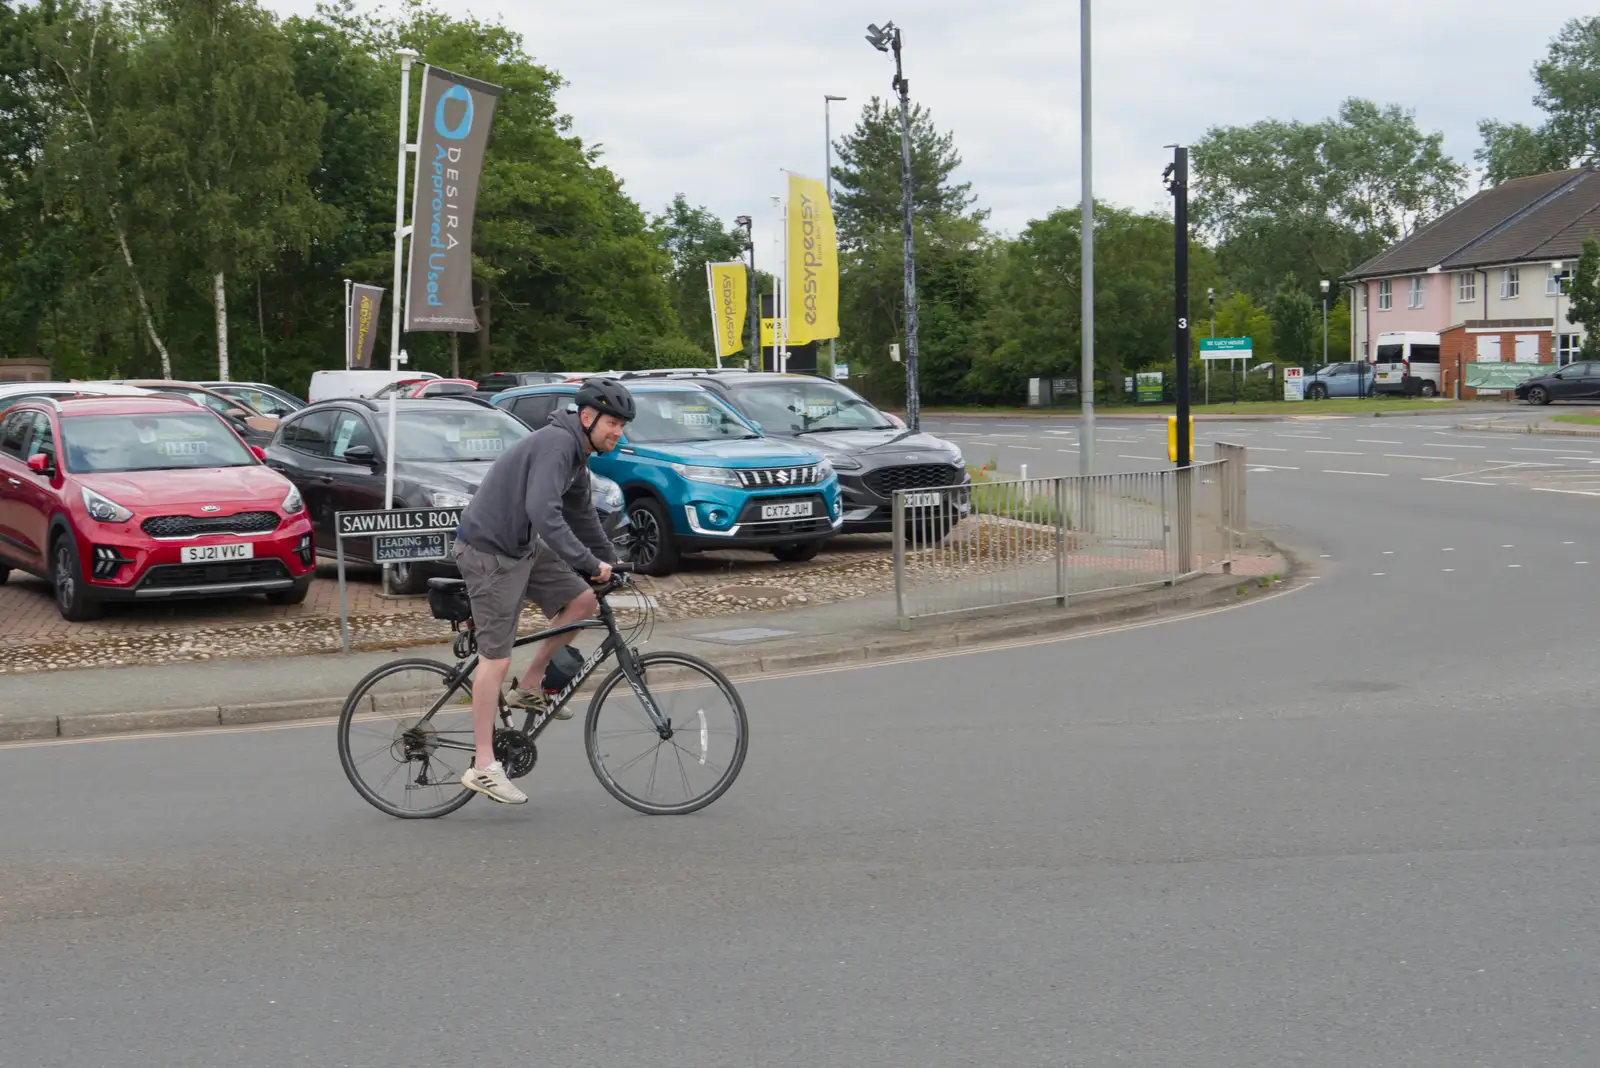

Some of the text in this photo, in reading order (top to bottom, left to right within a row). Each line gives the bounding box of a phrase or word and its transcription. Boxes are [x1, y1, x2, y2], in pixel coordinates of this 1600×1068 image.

[445, 146, 463, 251] DESIRA
[426, 143, 448, 307] Approved Used
[800, 193, 822, 326] easypeasy
[1178, 317, 1187, 329] 3
[766, 502, 809, 517] CX72 JUH
[342, 511, 461, 532] SAWMILLS ROA
[380, 535, 441, 548] LEADING TO
[190, 545, 245, 560] SJ21 VVC
[378, 546, 442, 559] SANDY LANE
